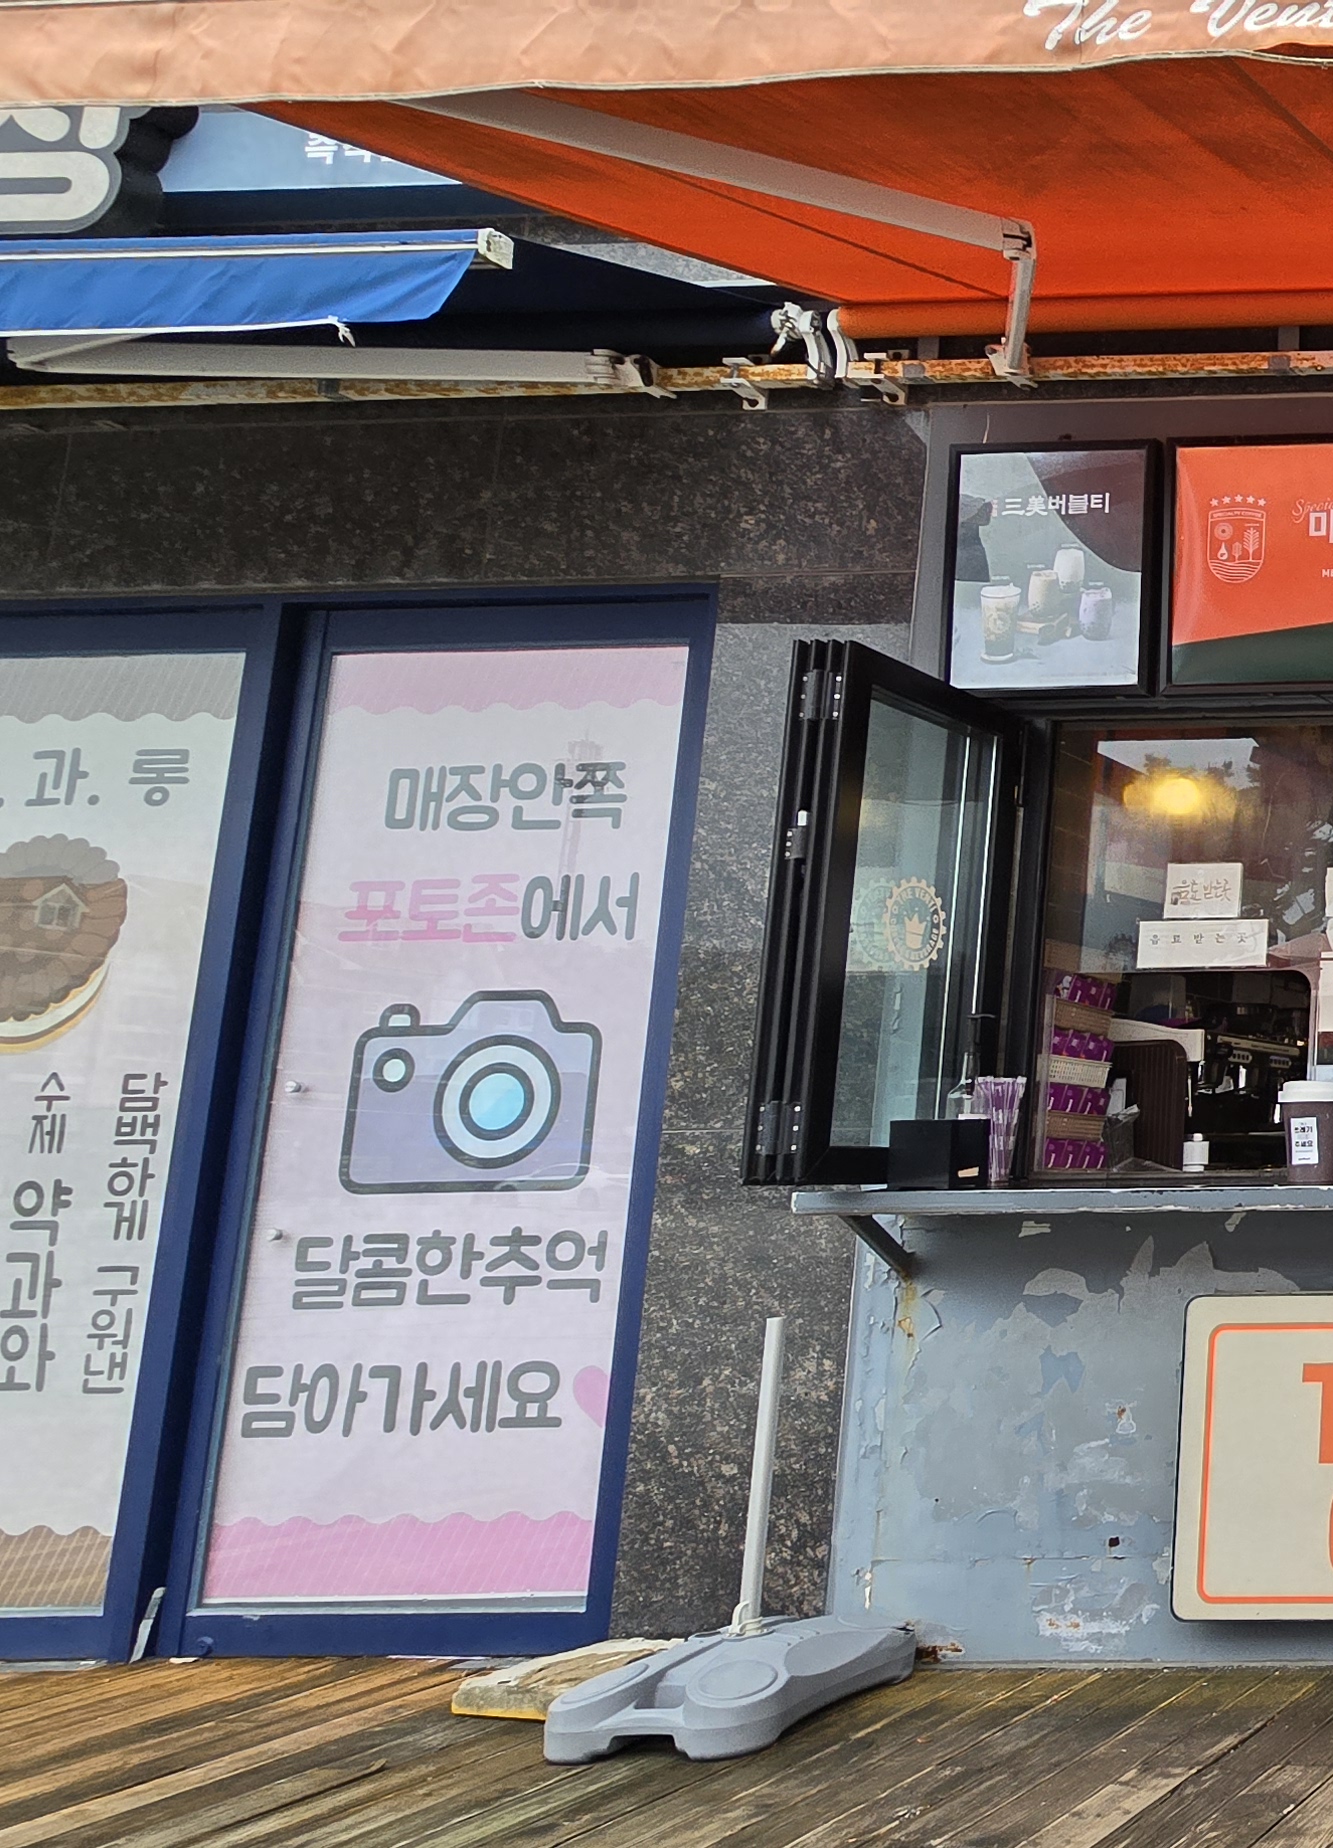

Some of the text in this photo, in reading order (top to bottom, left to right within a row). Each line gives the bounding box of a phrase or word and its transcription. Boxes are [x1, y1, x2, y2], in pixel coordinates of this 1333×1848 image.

[1022, 0, 1151, 50] The
[384, 760, 628, 832] 매장안쪽
[337, 872, 641, 942] 포토존에서
[28, 1071, 71, 1155] 수제
[103, 1071, 169, 1241] 담백하게
[0, 1178, 74, 1393] 약과와
[291, 1228, 610, 1311] 달콤한추억
[81, 1265, 140, 1395] 구워낸
[240, 1360, 564, 1438] 담아가세요
